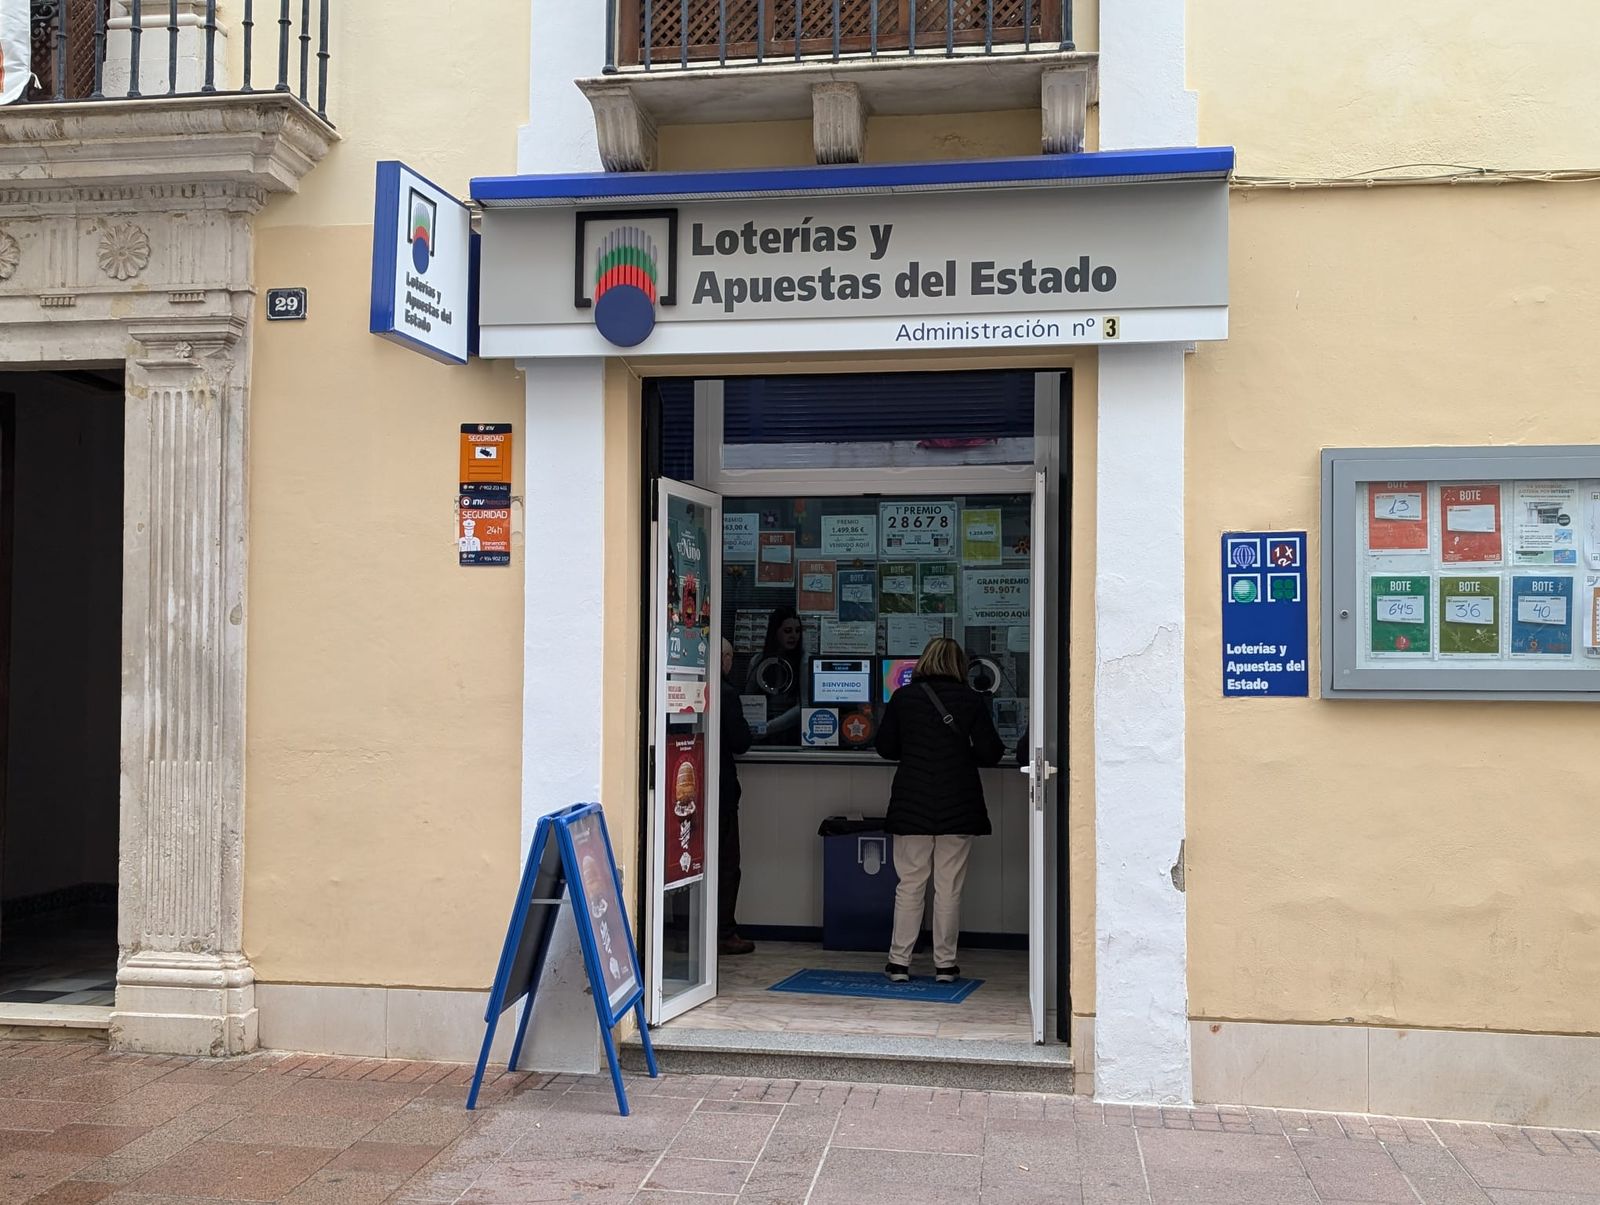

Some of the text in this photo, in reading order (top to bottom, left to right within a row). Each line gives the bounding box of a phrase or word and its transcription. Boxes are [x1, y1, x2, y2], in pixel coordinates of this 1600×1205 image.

[692, 217, 894, 260] Loterías y
[406, 272, 442, 304] Loterías y
[692, 256, 1118, 313] Apuestas del Estado
[274, 296, 298, 312] 29
[406, 291, 452, 325] Apuestas del
[405, 309, 431, 332] Estado
[895, 317, 1118, 343] Administración nº 3
[1460, 490, 1481, 501] BOTE
[904, 506, 942, 514] PREMIO
[1389, 499, 1409, 514] 13
[462, 510, 508, 519] SEGURIDAD
[888, 516, 948, 528] 28678
[486, 526, 503, 535] 24h
[1390, 581, 1411, 592] BOTE
[1459, 582, 1481, 592] BOTE
[1532, 581, 1554, 592] BOTE
[1533, 604, 1550, 618] 40
[1226, 642, 1287, 656] Loterías y
[1226, 660, 1305, 674] Apuestas del
[1227, 678, 1269, 690] Estado
